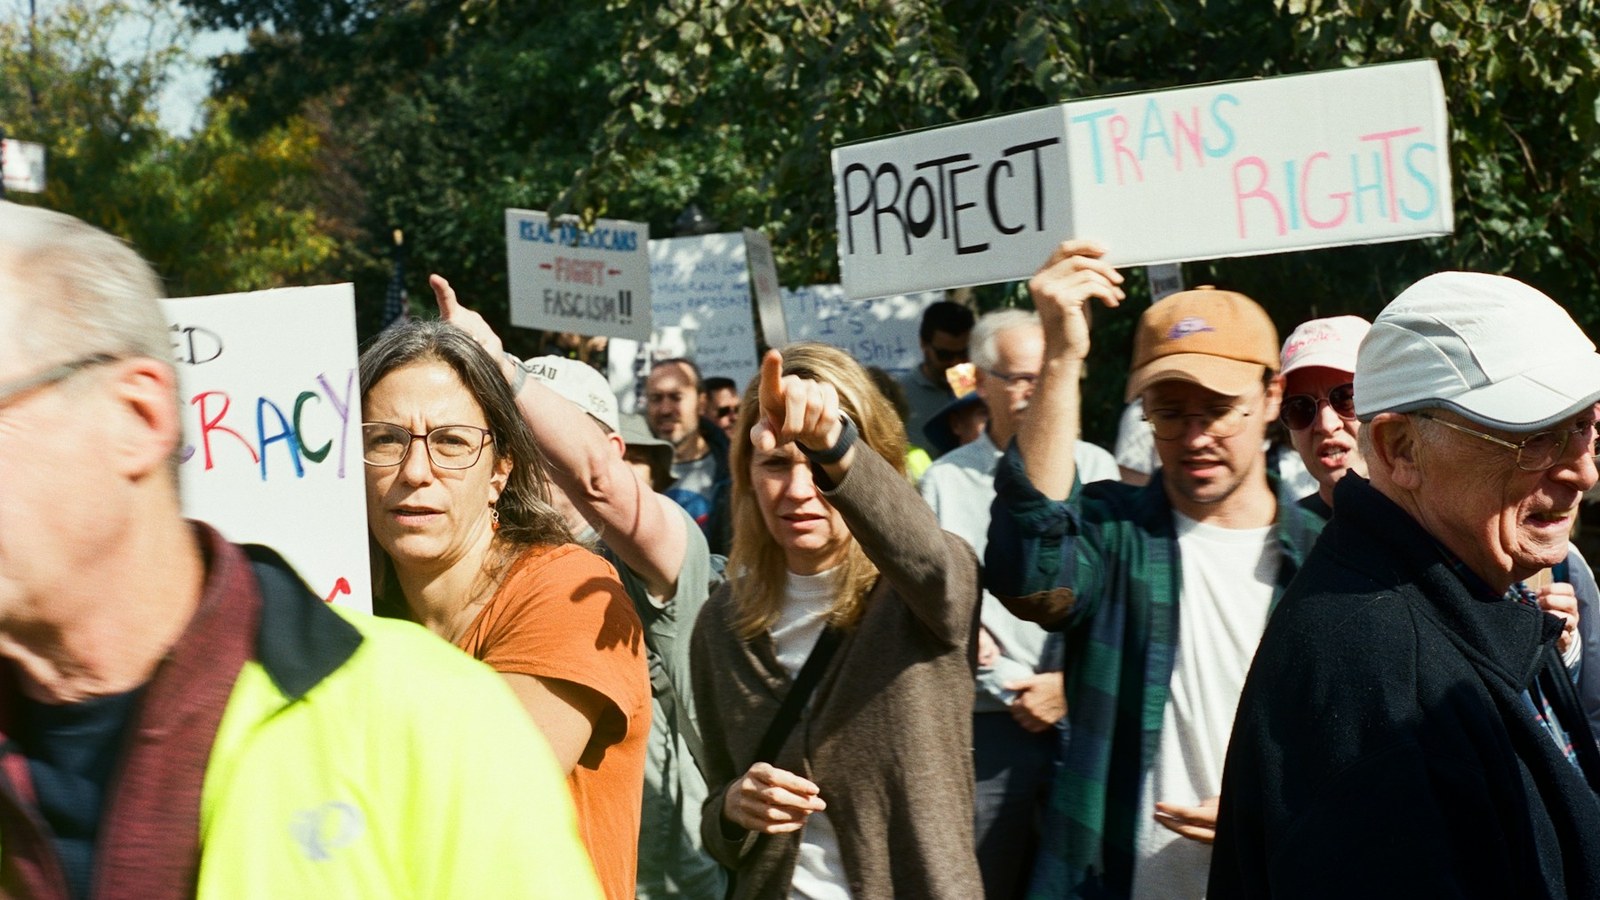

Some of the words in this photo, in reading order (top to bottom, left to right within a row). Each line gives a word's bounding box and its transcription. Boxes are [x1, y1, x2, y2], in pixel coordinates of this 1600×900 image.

[843, 137, 1061, 255] PROTECT
[1071, 93, 1242, 186] TRANS
[1232, 125, 1438, 239] RIGHTS
[180, 368, 354, 481] RACY
